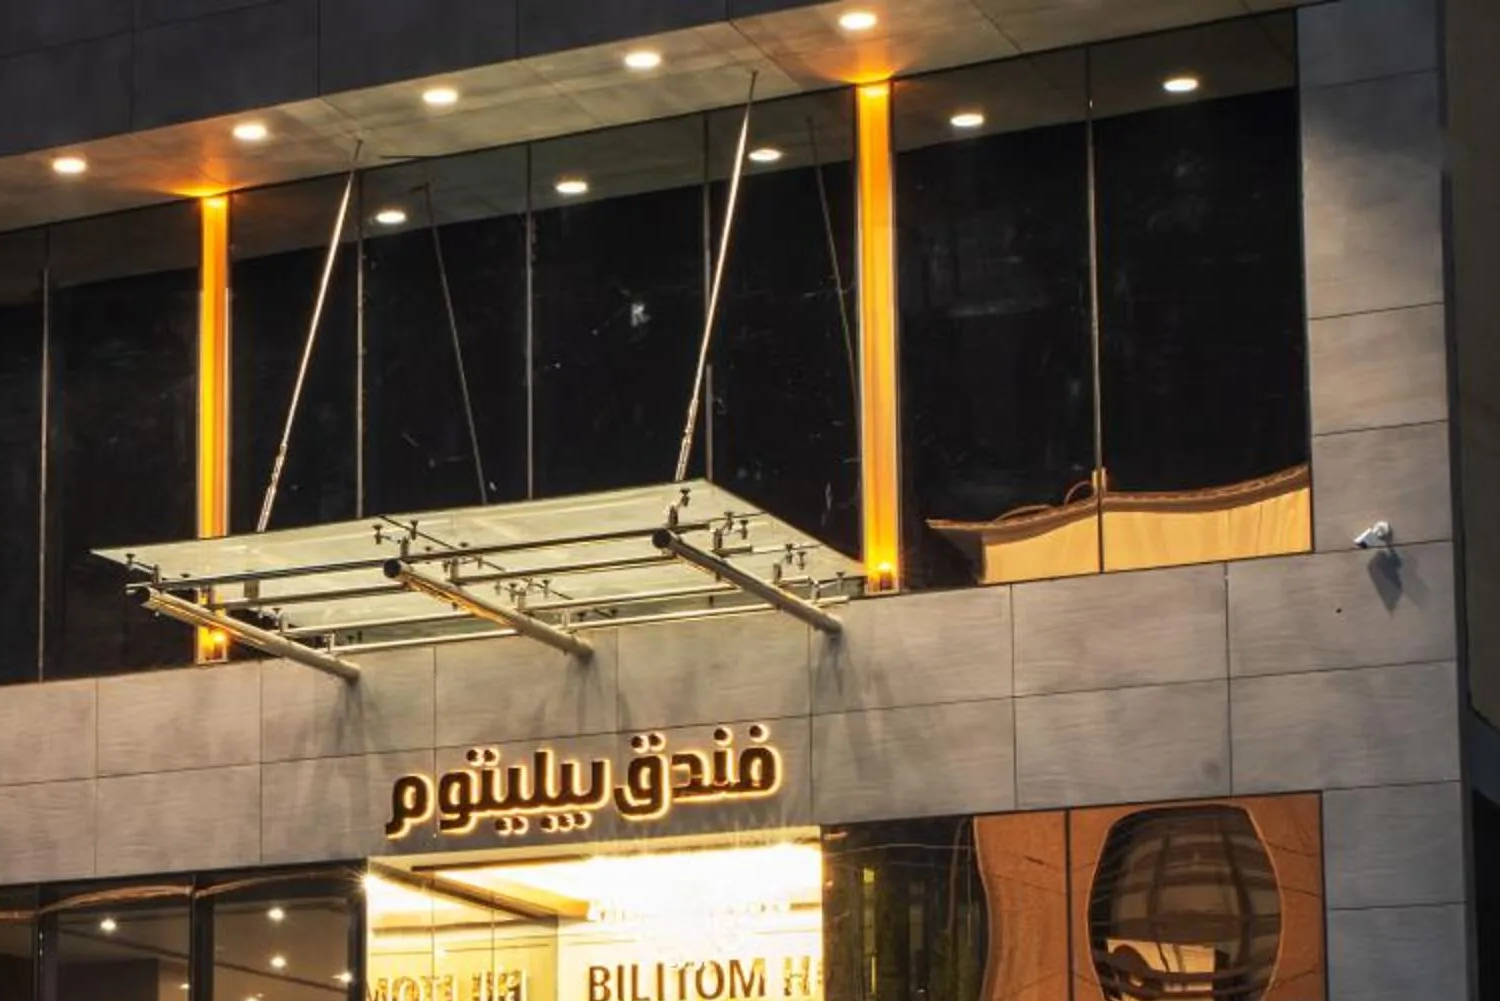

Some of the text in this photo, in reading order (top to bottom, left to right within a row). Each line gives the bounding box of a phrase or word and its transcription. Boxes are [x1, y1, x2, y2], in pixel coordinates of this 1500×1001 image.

[385, 724, 781, 837] فندق بيليتوم
[783, 955, 823, 996] H
